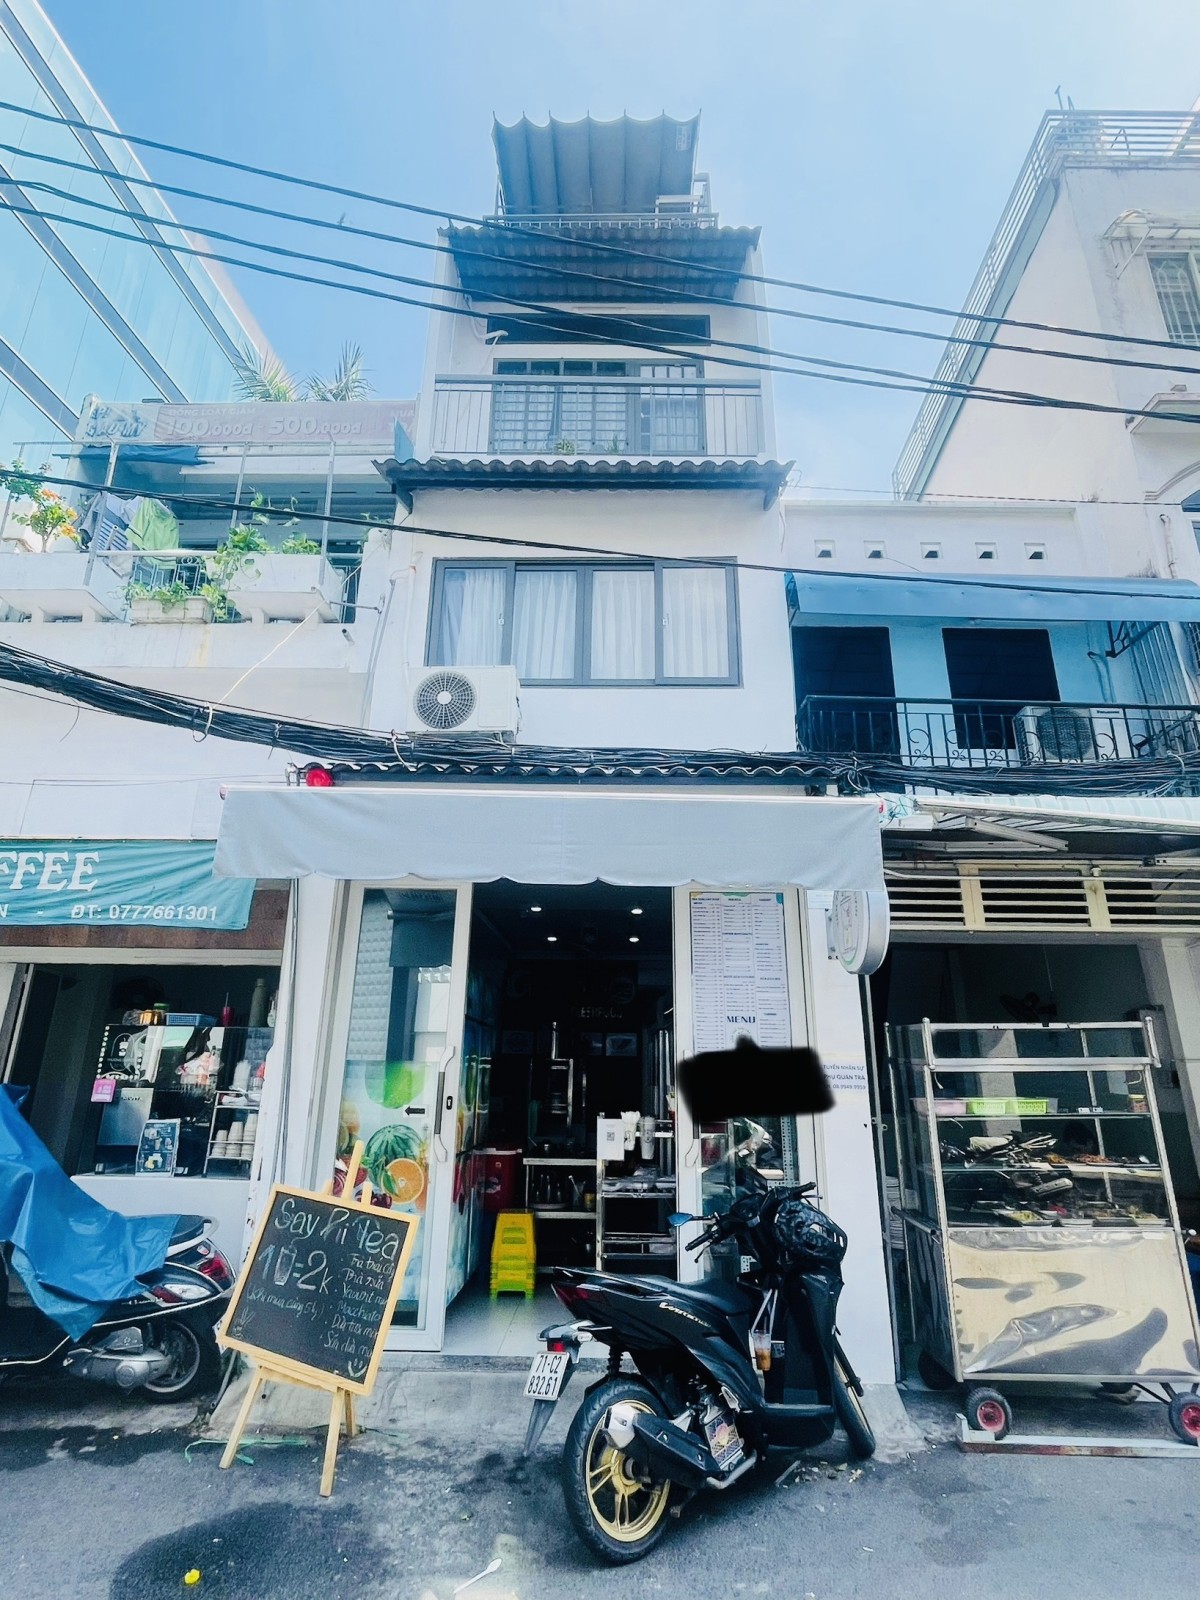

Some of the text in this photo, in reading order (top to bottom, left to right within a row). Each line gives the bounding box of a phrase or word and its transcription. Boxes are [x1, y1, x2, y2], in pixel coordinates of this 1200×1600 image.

[71, 904, 103, 919] ĐT:
[109, 904, 218, 921] 0777661301
[726, 1015, 756, 1024] MENU
[275, 1198, 320, 1240] Say
